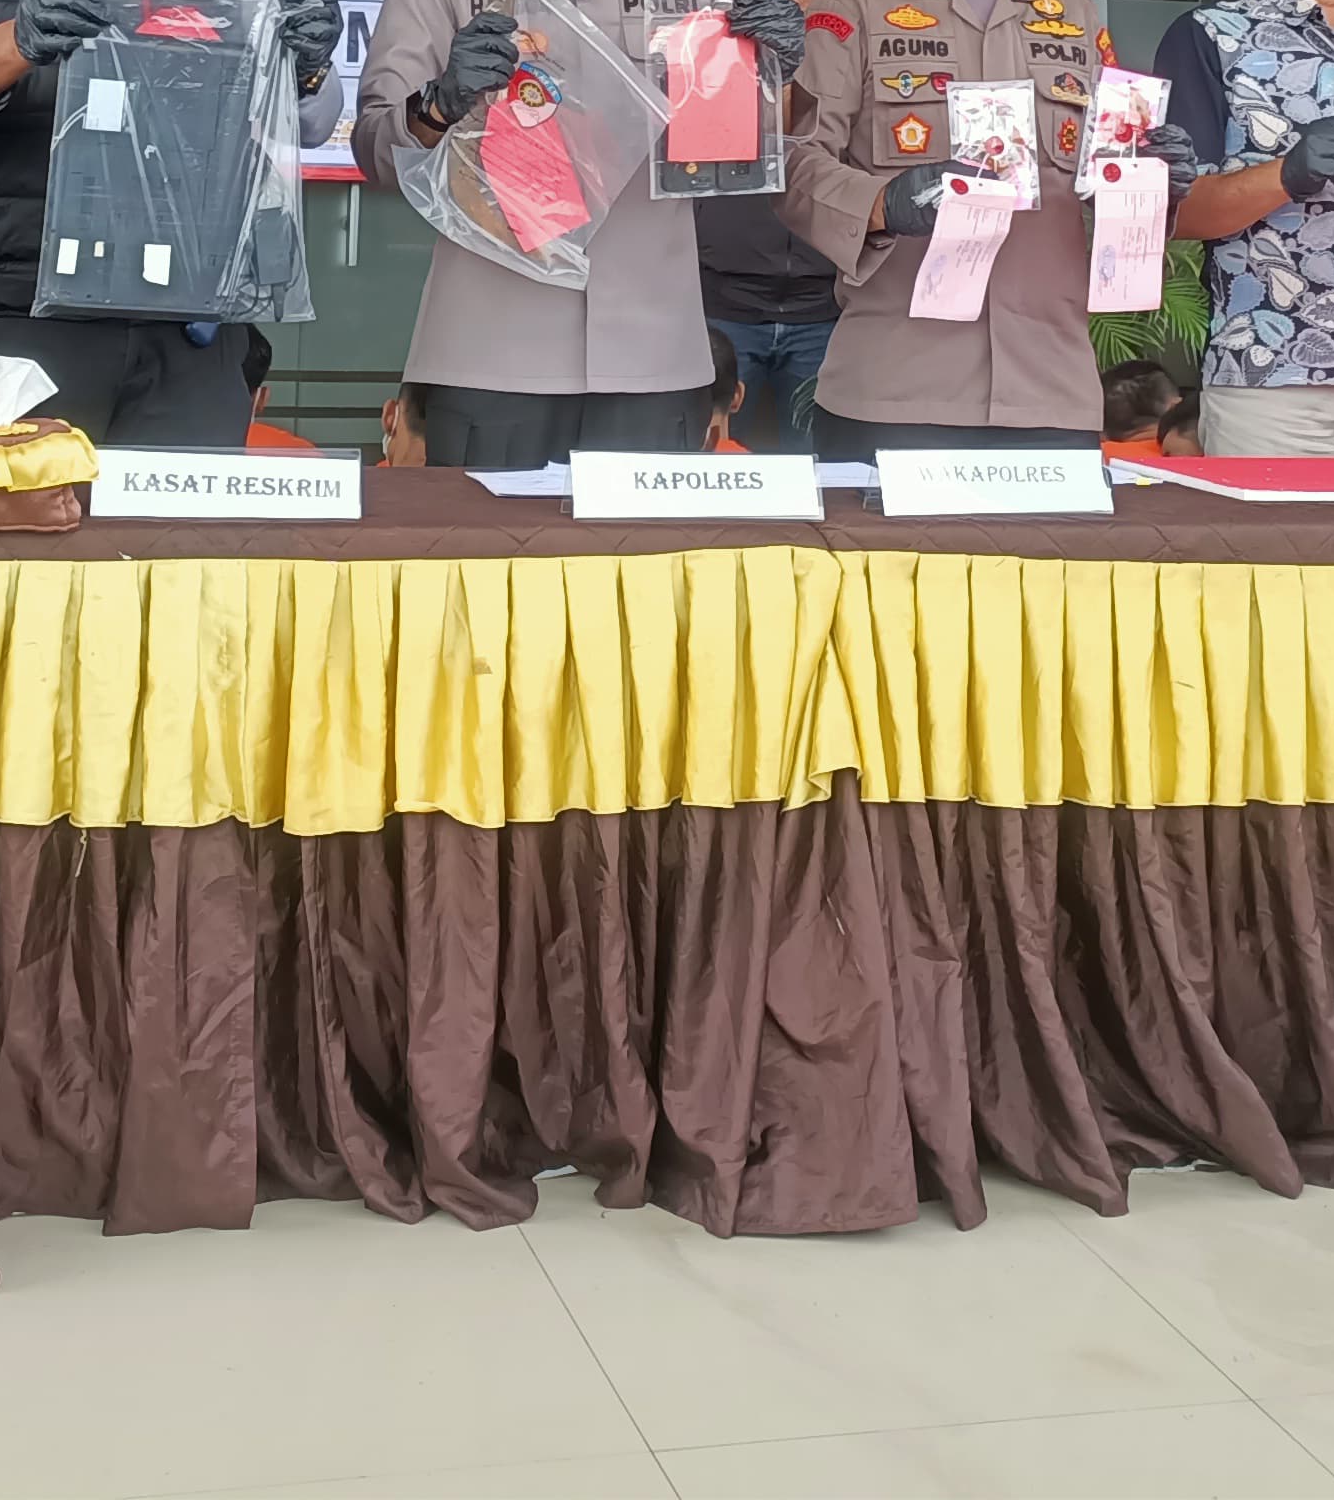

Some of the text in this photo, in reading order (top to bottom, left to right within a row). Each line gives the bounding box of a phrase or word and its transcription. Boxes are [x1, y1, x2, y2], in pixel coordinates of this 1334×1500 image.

[878, 38, 949, 58] AGUNG
[1030, 42, 1087, 66] POLRI
[122, 472, 342, 498] KASAT RESKRIM
[633, 471, 764, 491] KAPOLRES
